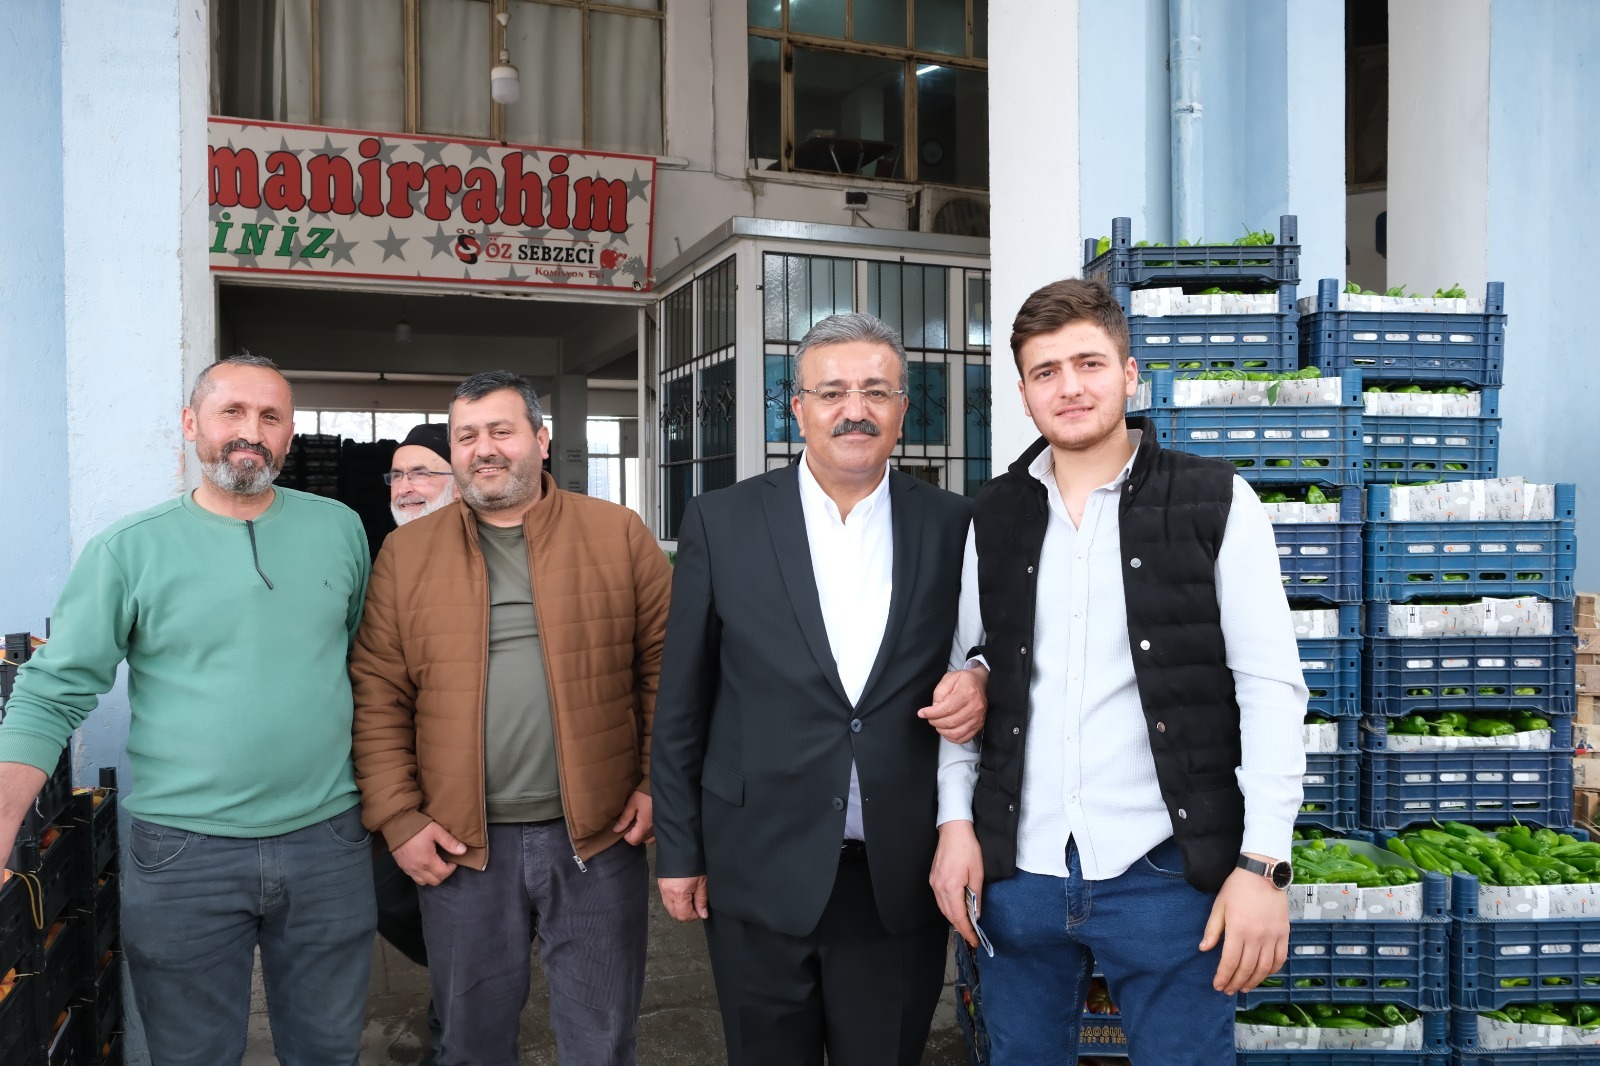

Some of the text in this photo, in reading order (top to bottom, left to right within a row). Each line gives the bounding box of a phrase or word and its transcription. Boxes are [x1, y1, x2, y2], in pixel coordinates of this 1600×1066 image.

[208, 138, 628, 233] manirrahim
[209, 212, 335, 258] İNİZ
[485, 236, 594, 264] ÖZ SEBZECİ
